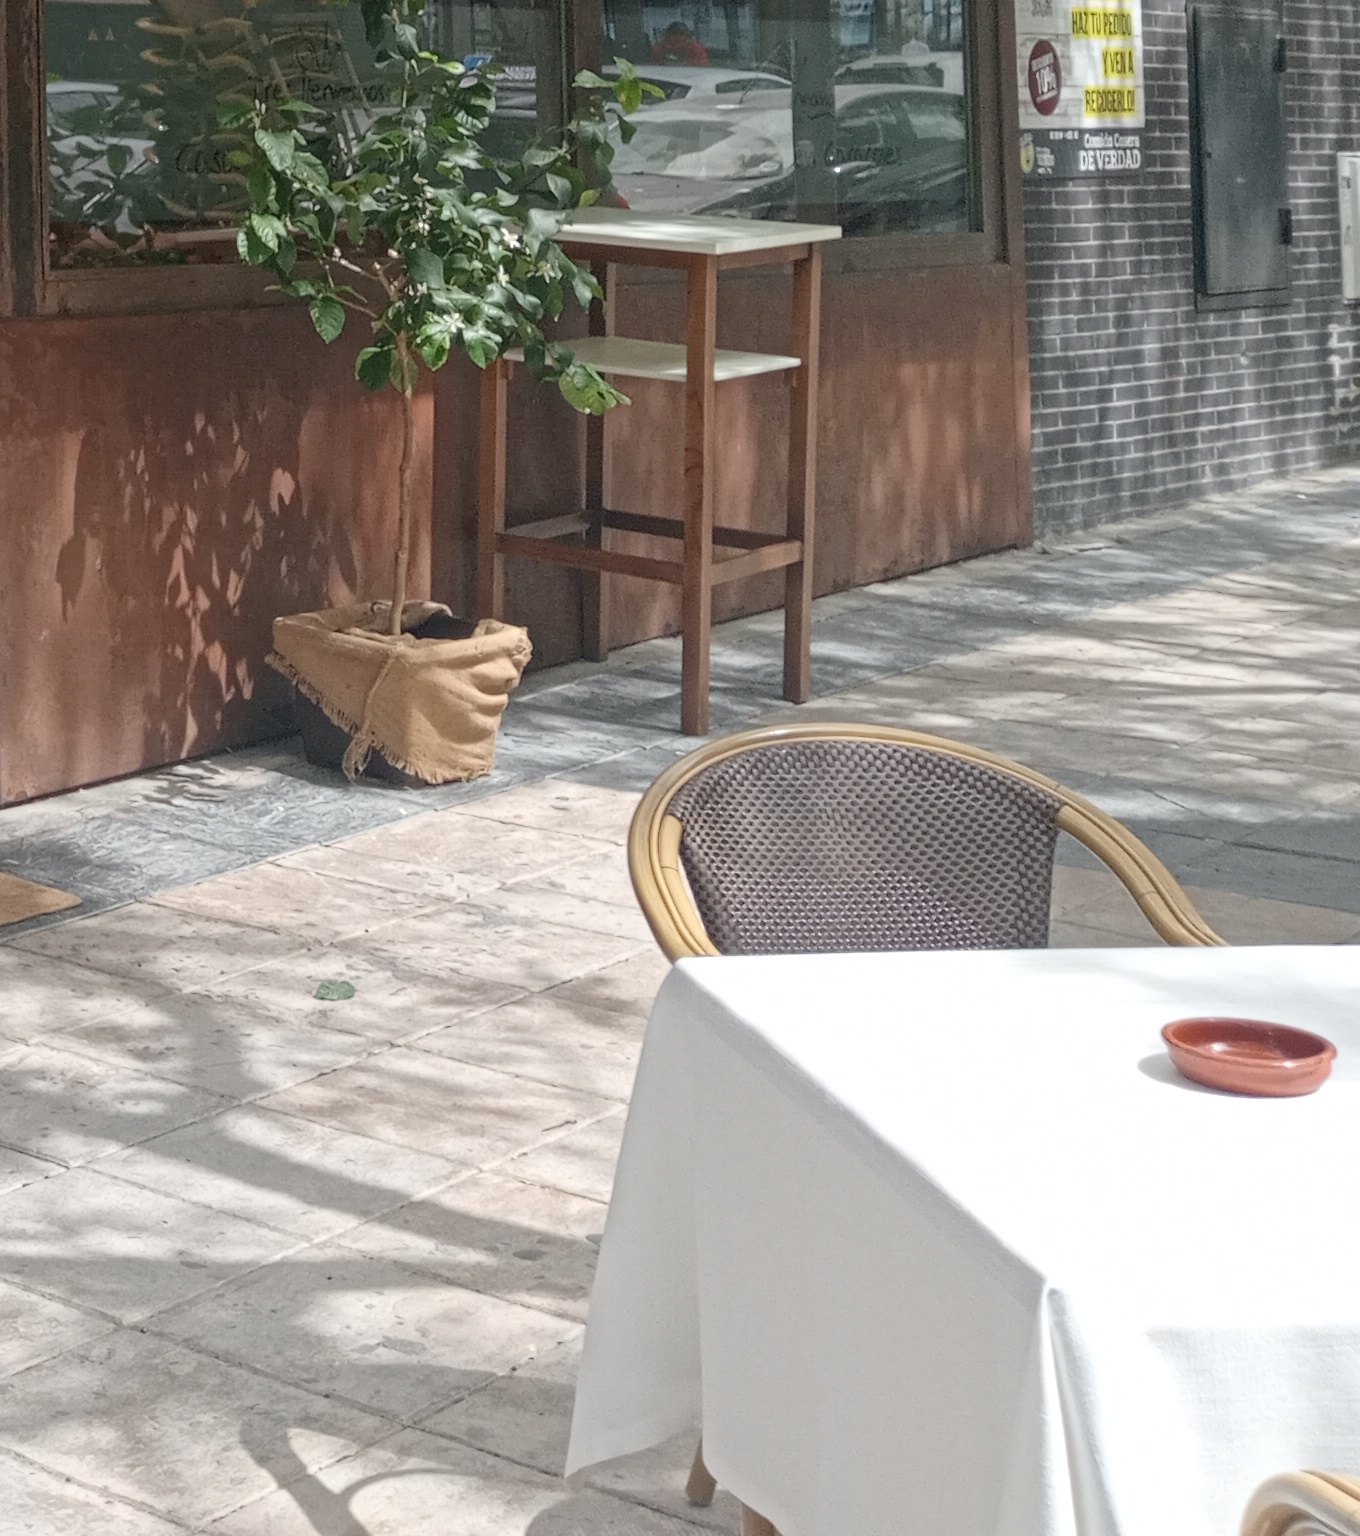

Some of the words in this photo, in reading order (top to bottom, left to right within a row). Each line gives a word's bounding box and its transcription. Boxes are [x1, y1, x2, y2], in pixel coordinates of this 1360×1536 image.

[1071, 11, 1088, 34] HAZ
[1091, 13, 1101, 35] TU
[1110, 50, 1125, 75] VEN
[1127, 50, 1134, 74] A
[1078, 149, 1096, 172] DE
[1096, 149, 1141, 171] VERDAD
